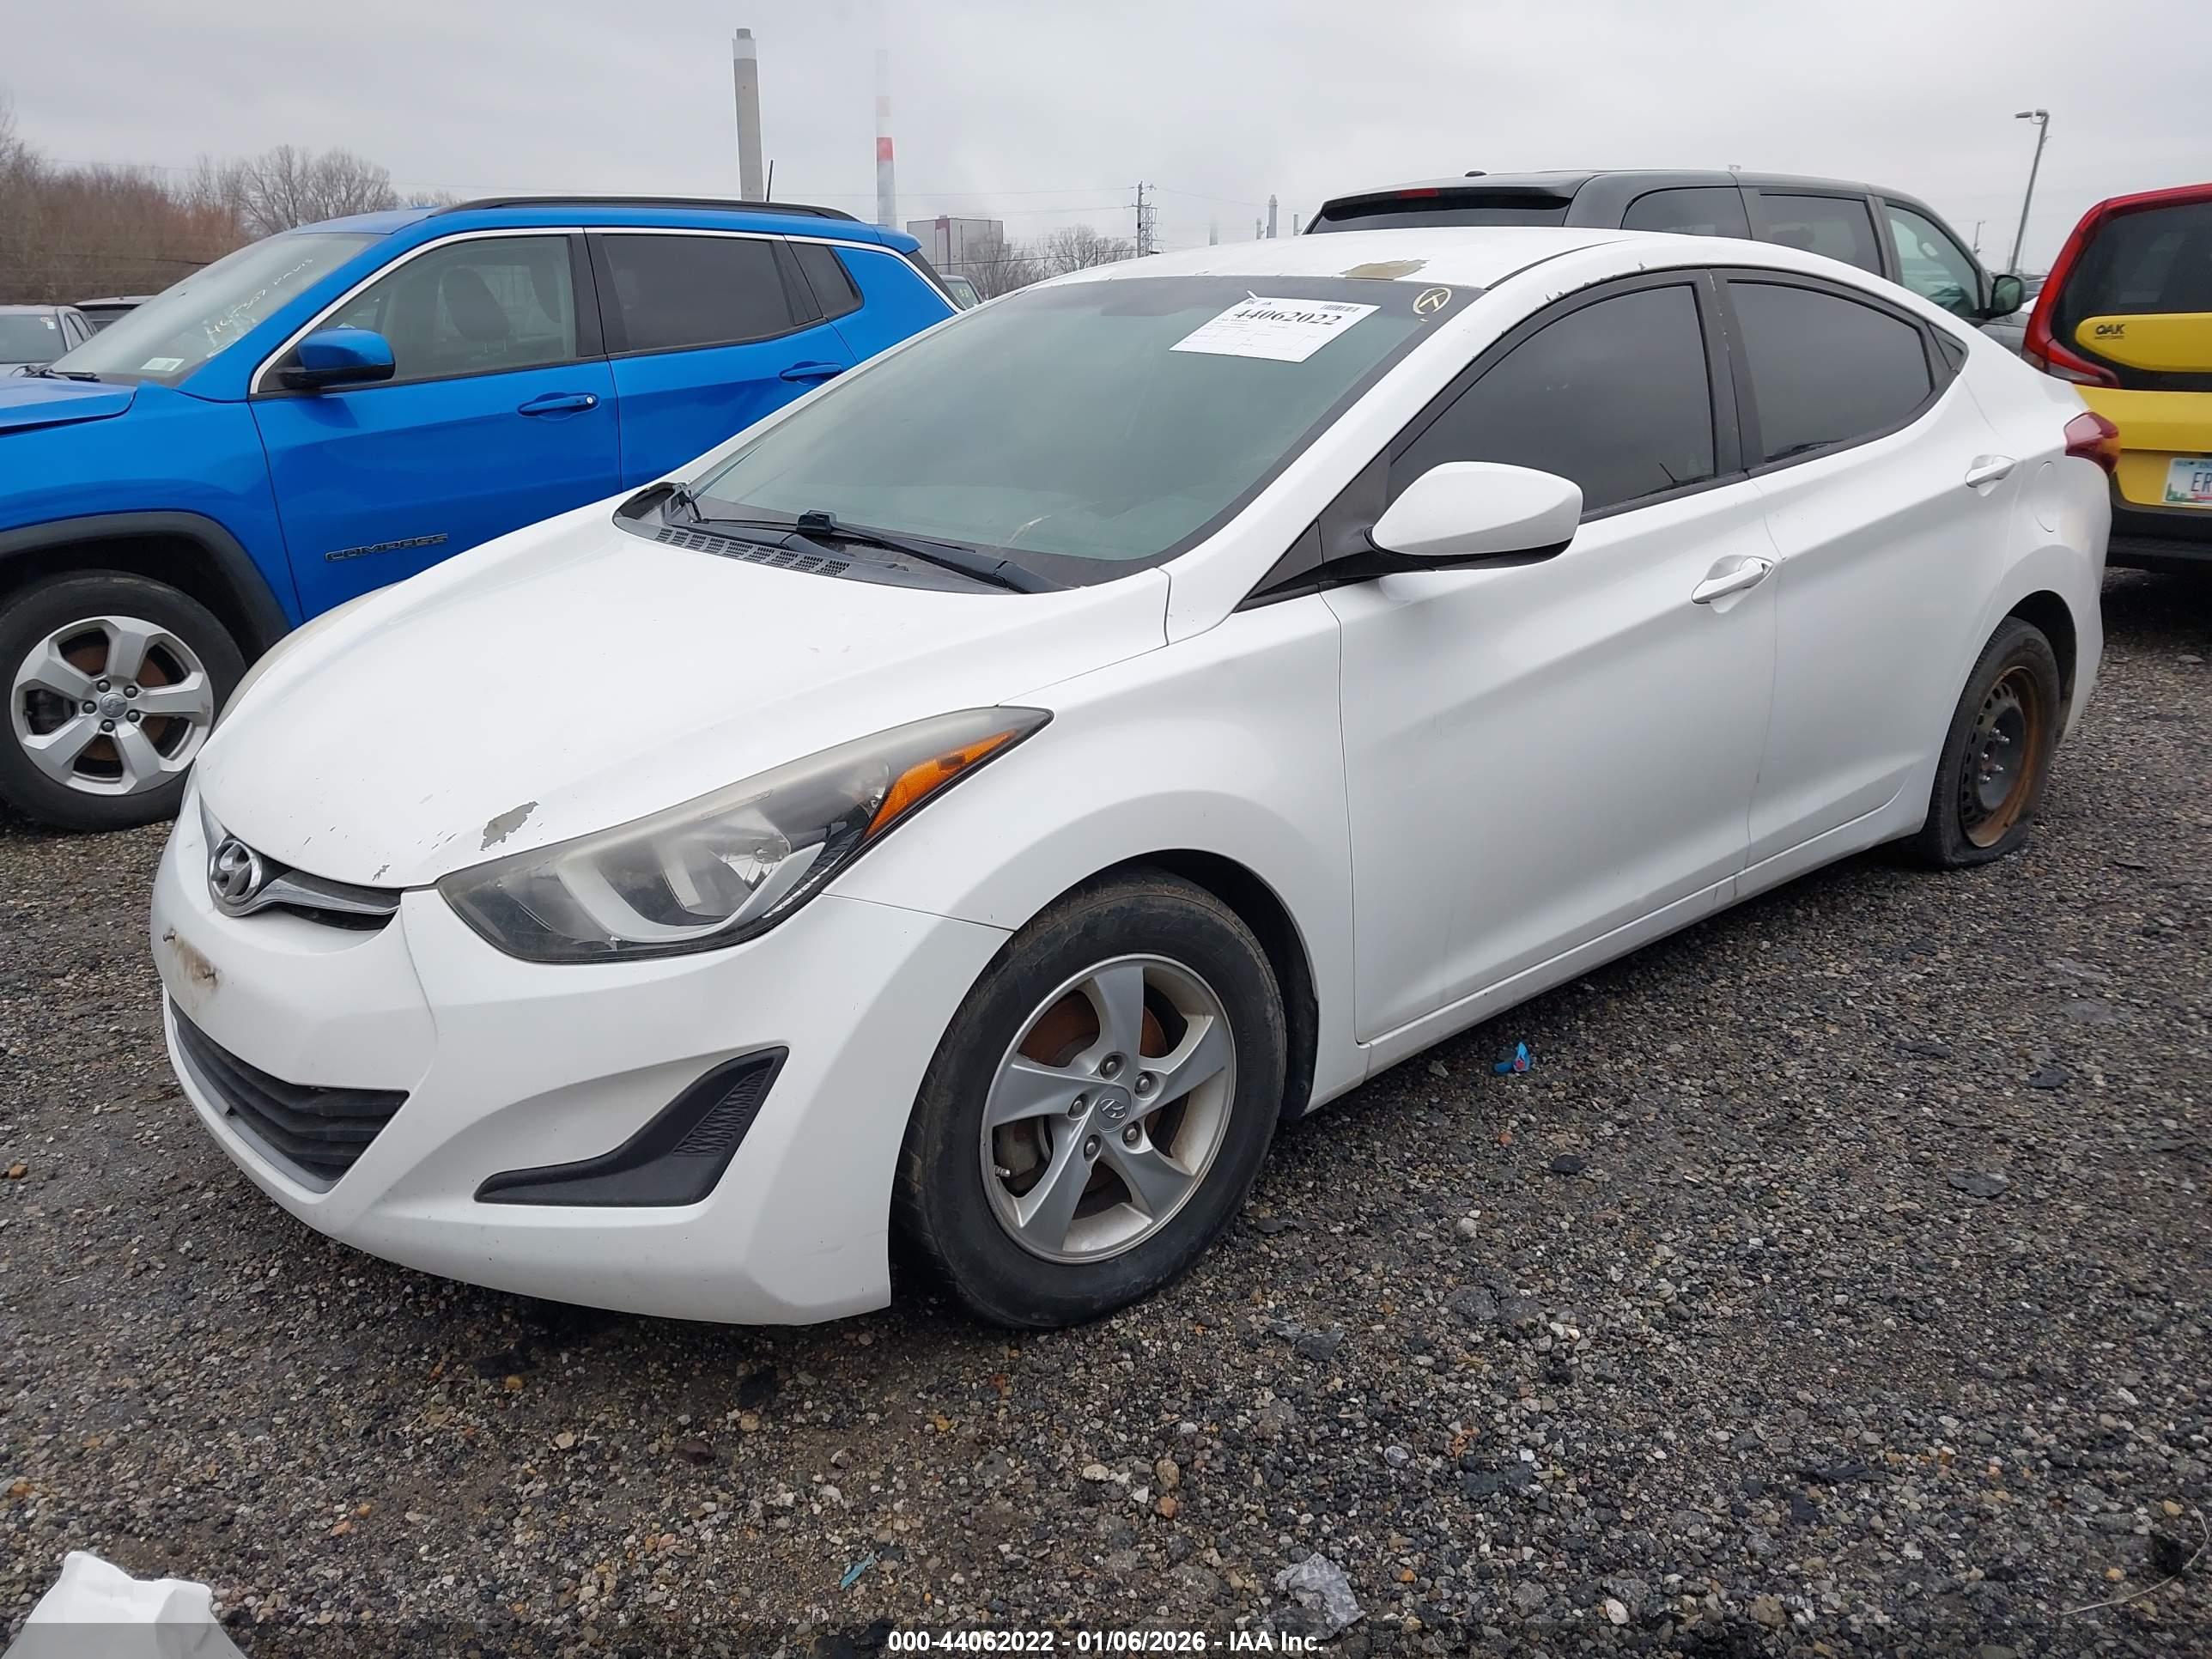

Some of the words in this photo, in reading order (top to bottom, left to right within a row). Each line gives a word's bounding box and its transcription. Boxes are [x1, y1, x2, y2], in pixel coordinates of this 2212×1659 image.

[1233, 308, 1342, 325] 44062022
[2095, 323, 2126, 335] OAK
[325, 532, 448, 562] COMPASS
